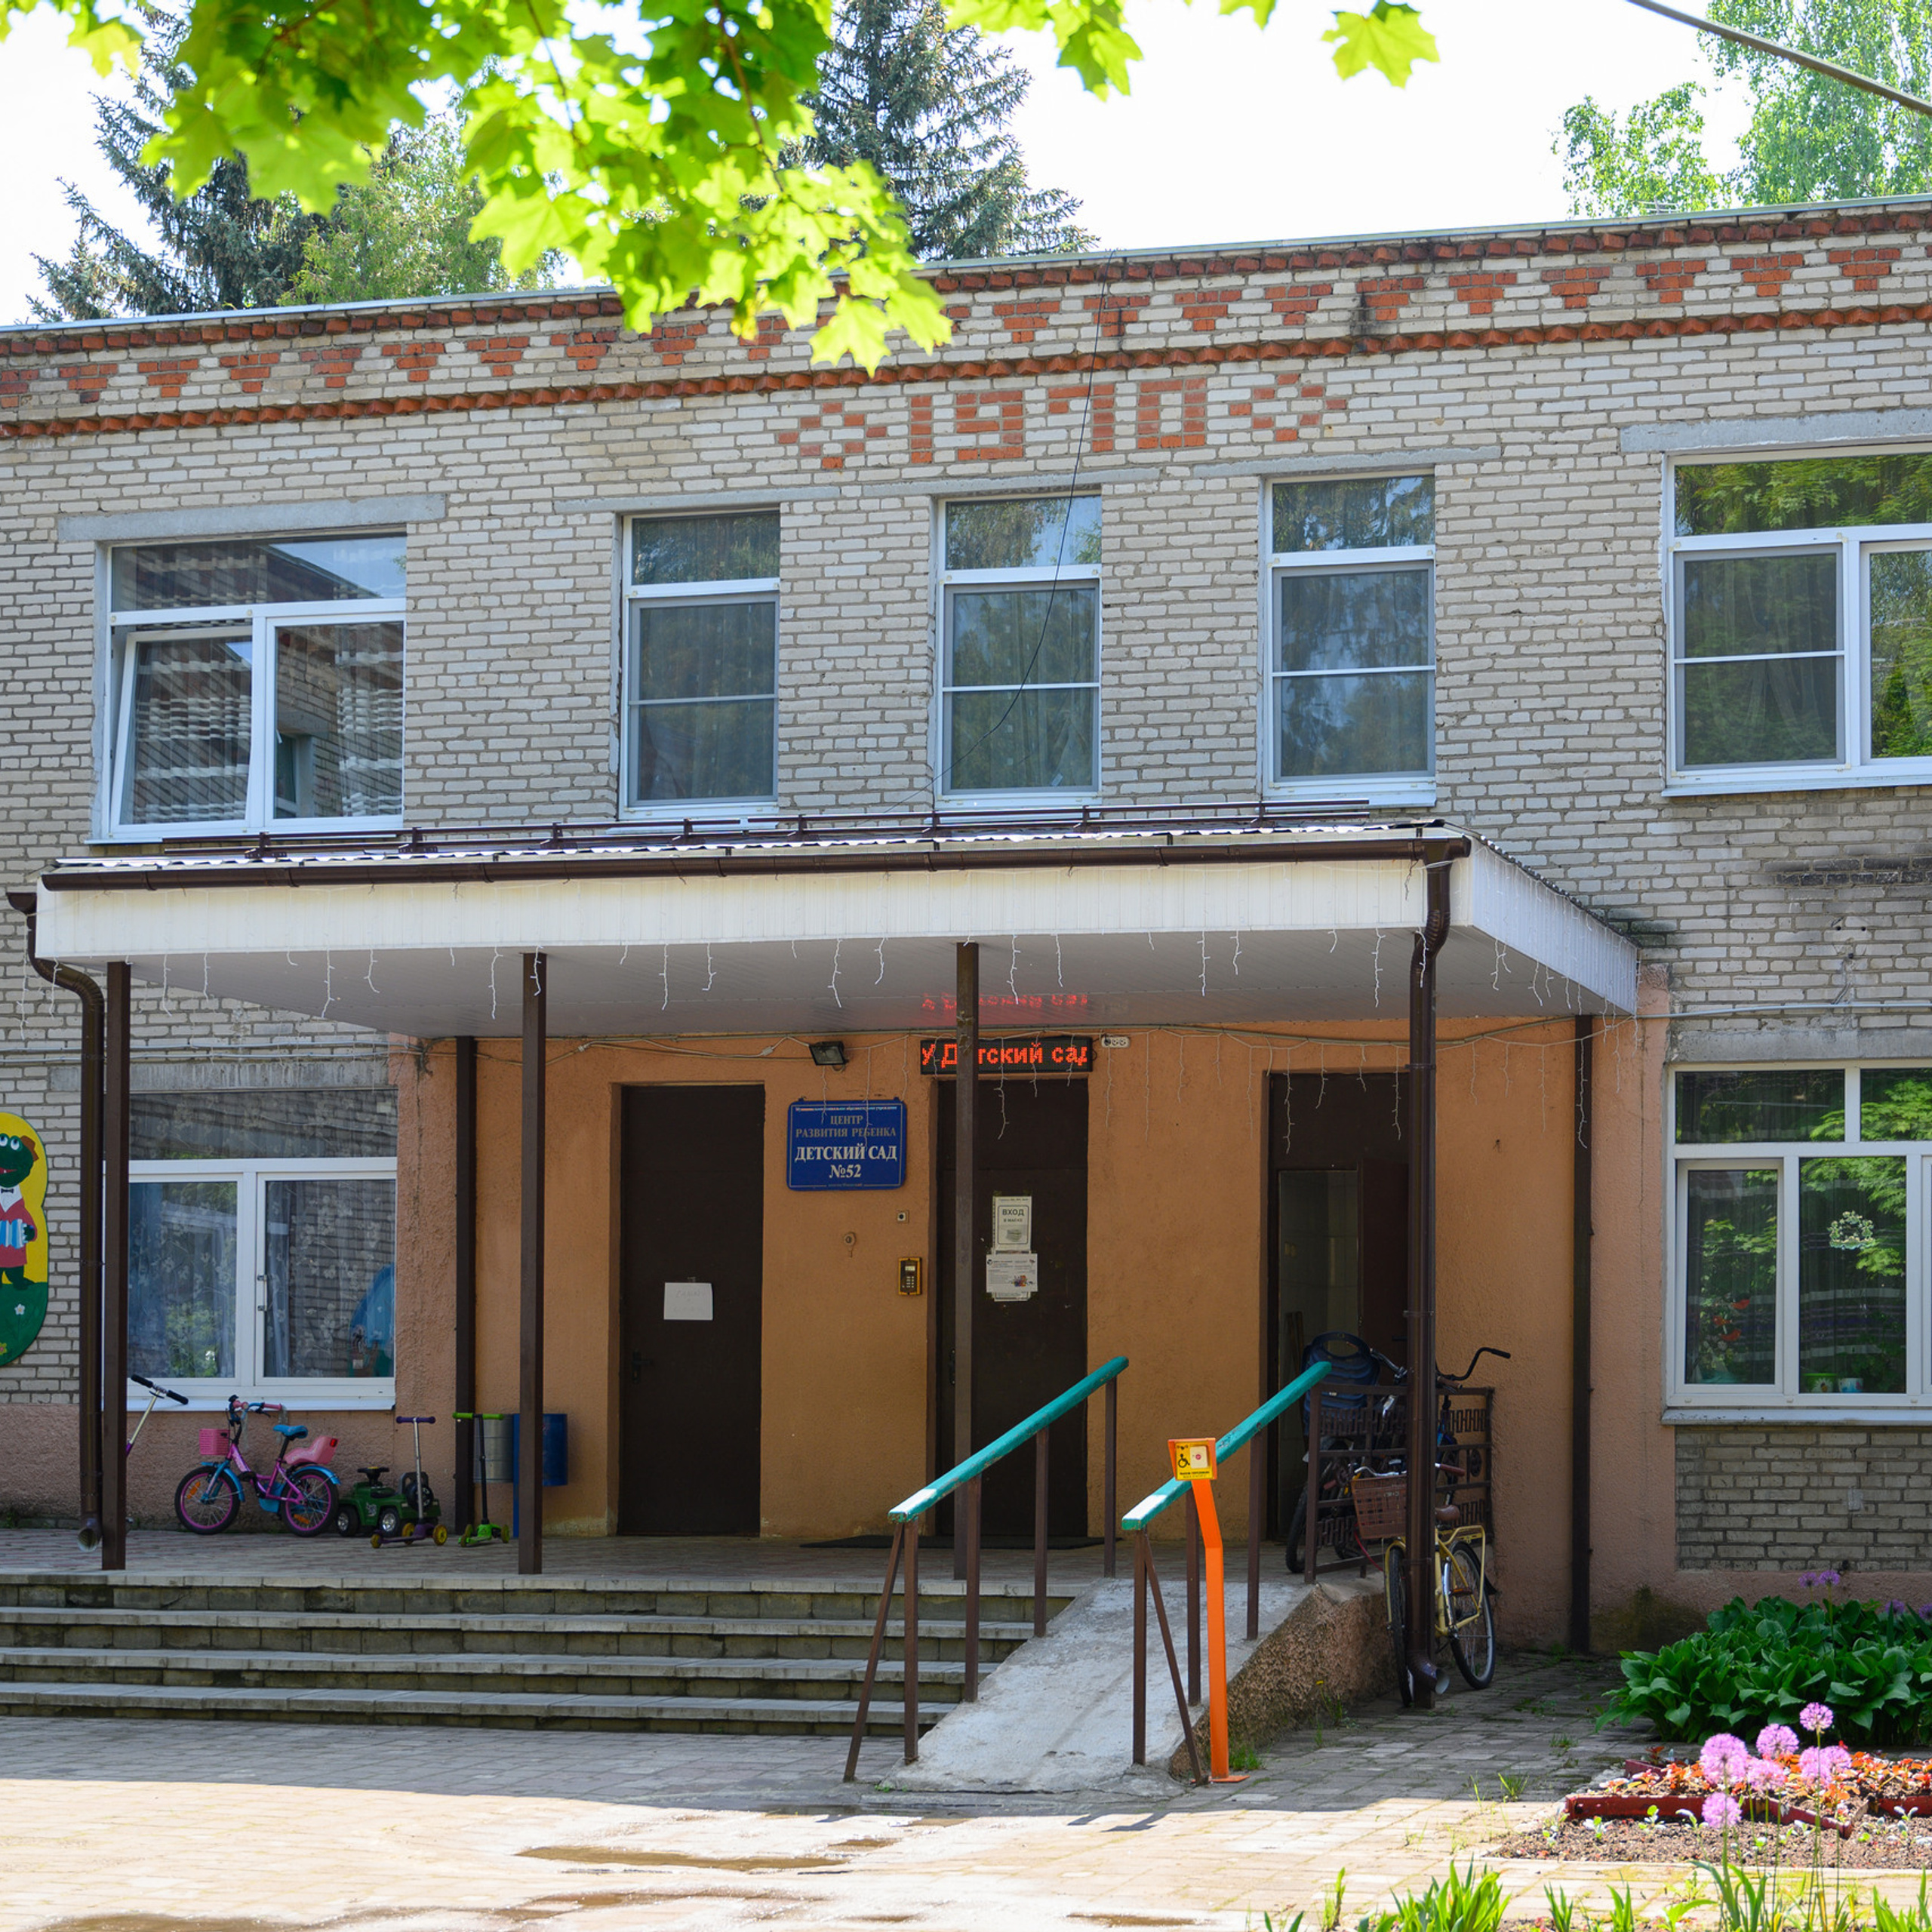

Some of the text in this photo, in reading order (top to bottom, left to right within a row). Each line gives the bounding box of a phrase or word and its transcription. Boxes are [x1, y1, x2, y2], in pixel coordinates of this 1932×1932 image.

[911, 377, 1208, 463] 1970
[941, 1042, 1043, 1069] Дтский
[830, 1115, 863, 1125] ЦЕНТР
[795, 1127, 896, 1138] РАЗВИТИЯ РЕБЕНКА
[795, 1143, 897, 1163] ДЕТСКИЙ САД
[829, 1164, 862, 1178] №52
